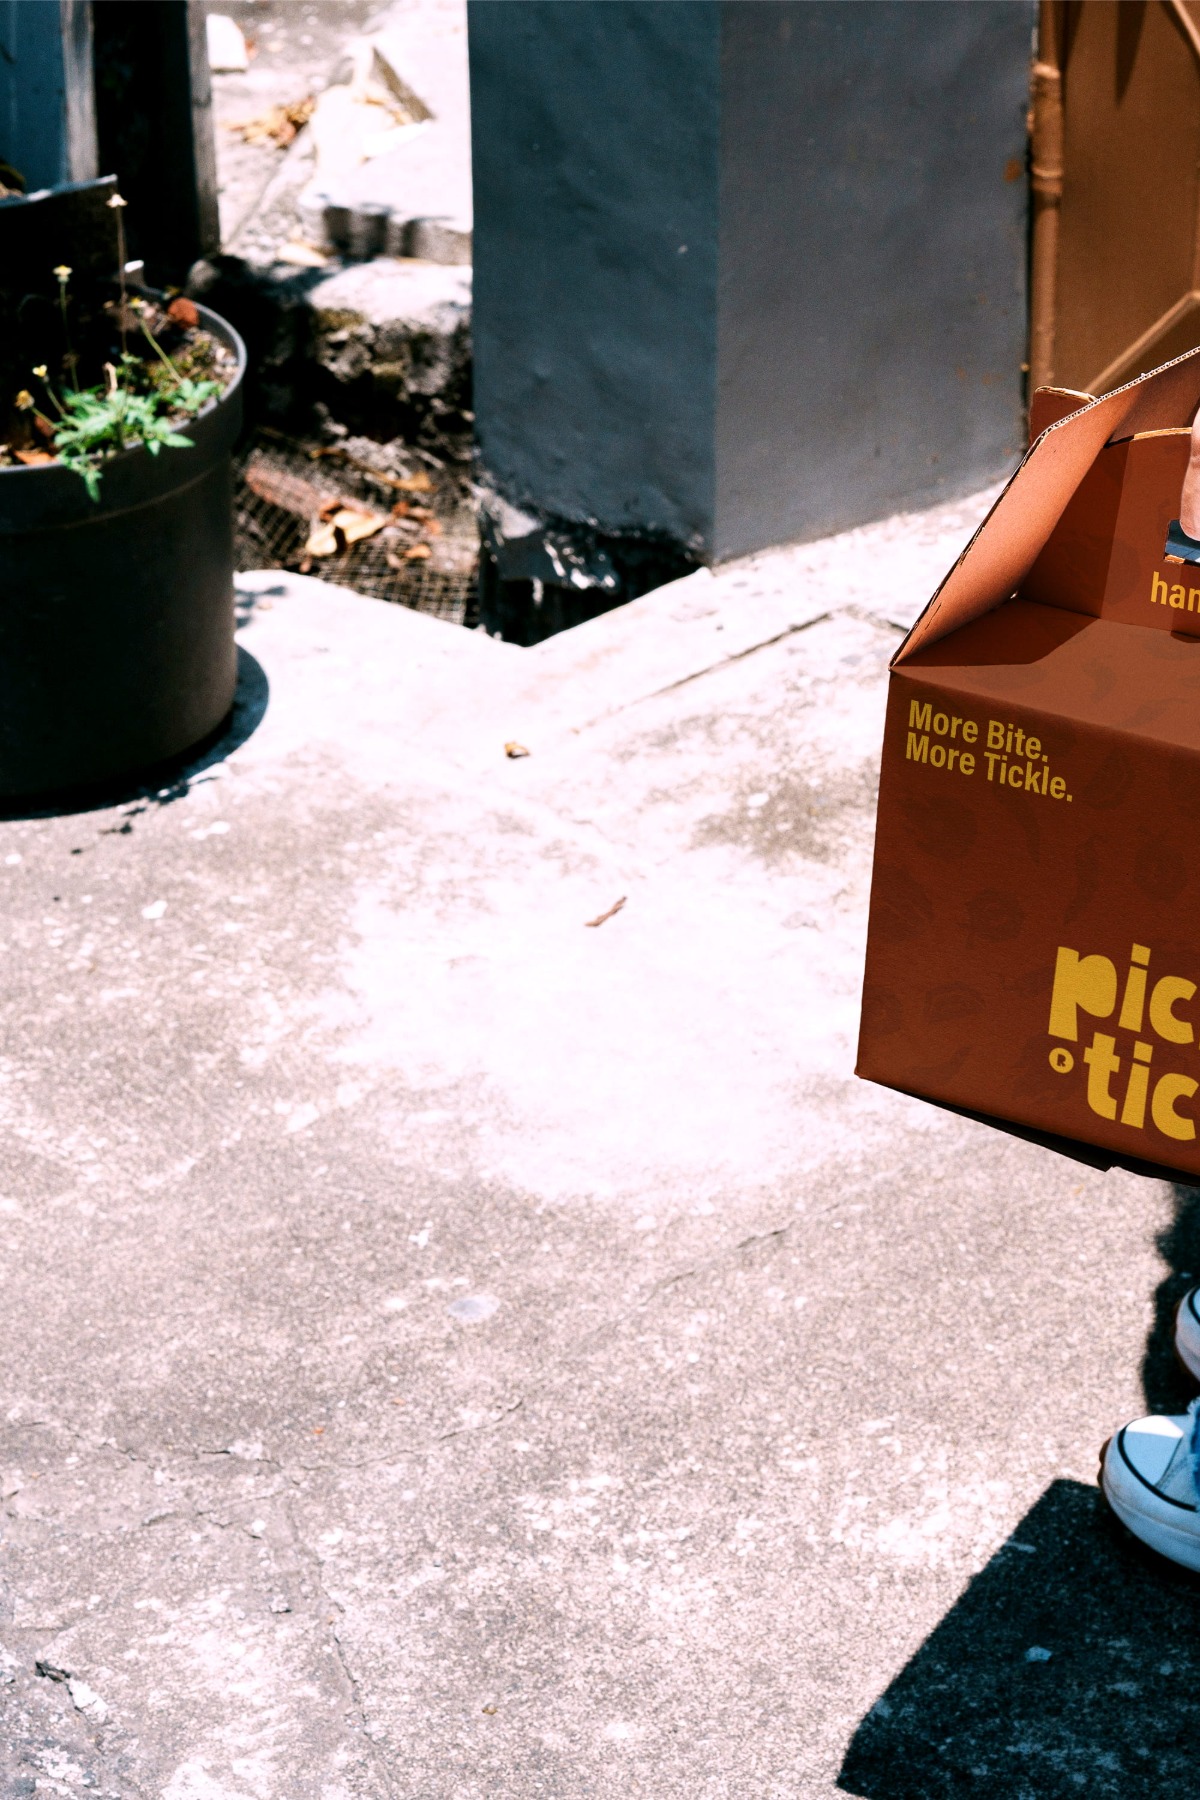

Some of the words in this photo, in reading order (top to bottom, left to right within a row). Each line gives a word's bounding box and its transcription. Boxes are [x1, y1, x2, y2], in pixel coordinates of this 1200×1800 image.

[908, 700, 979, 744] More
[986, 720, 1049, 763] Bite.
[905, 732, 976, 776] More
[983, 752, 1074, 803] Tickle.
